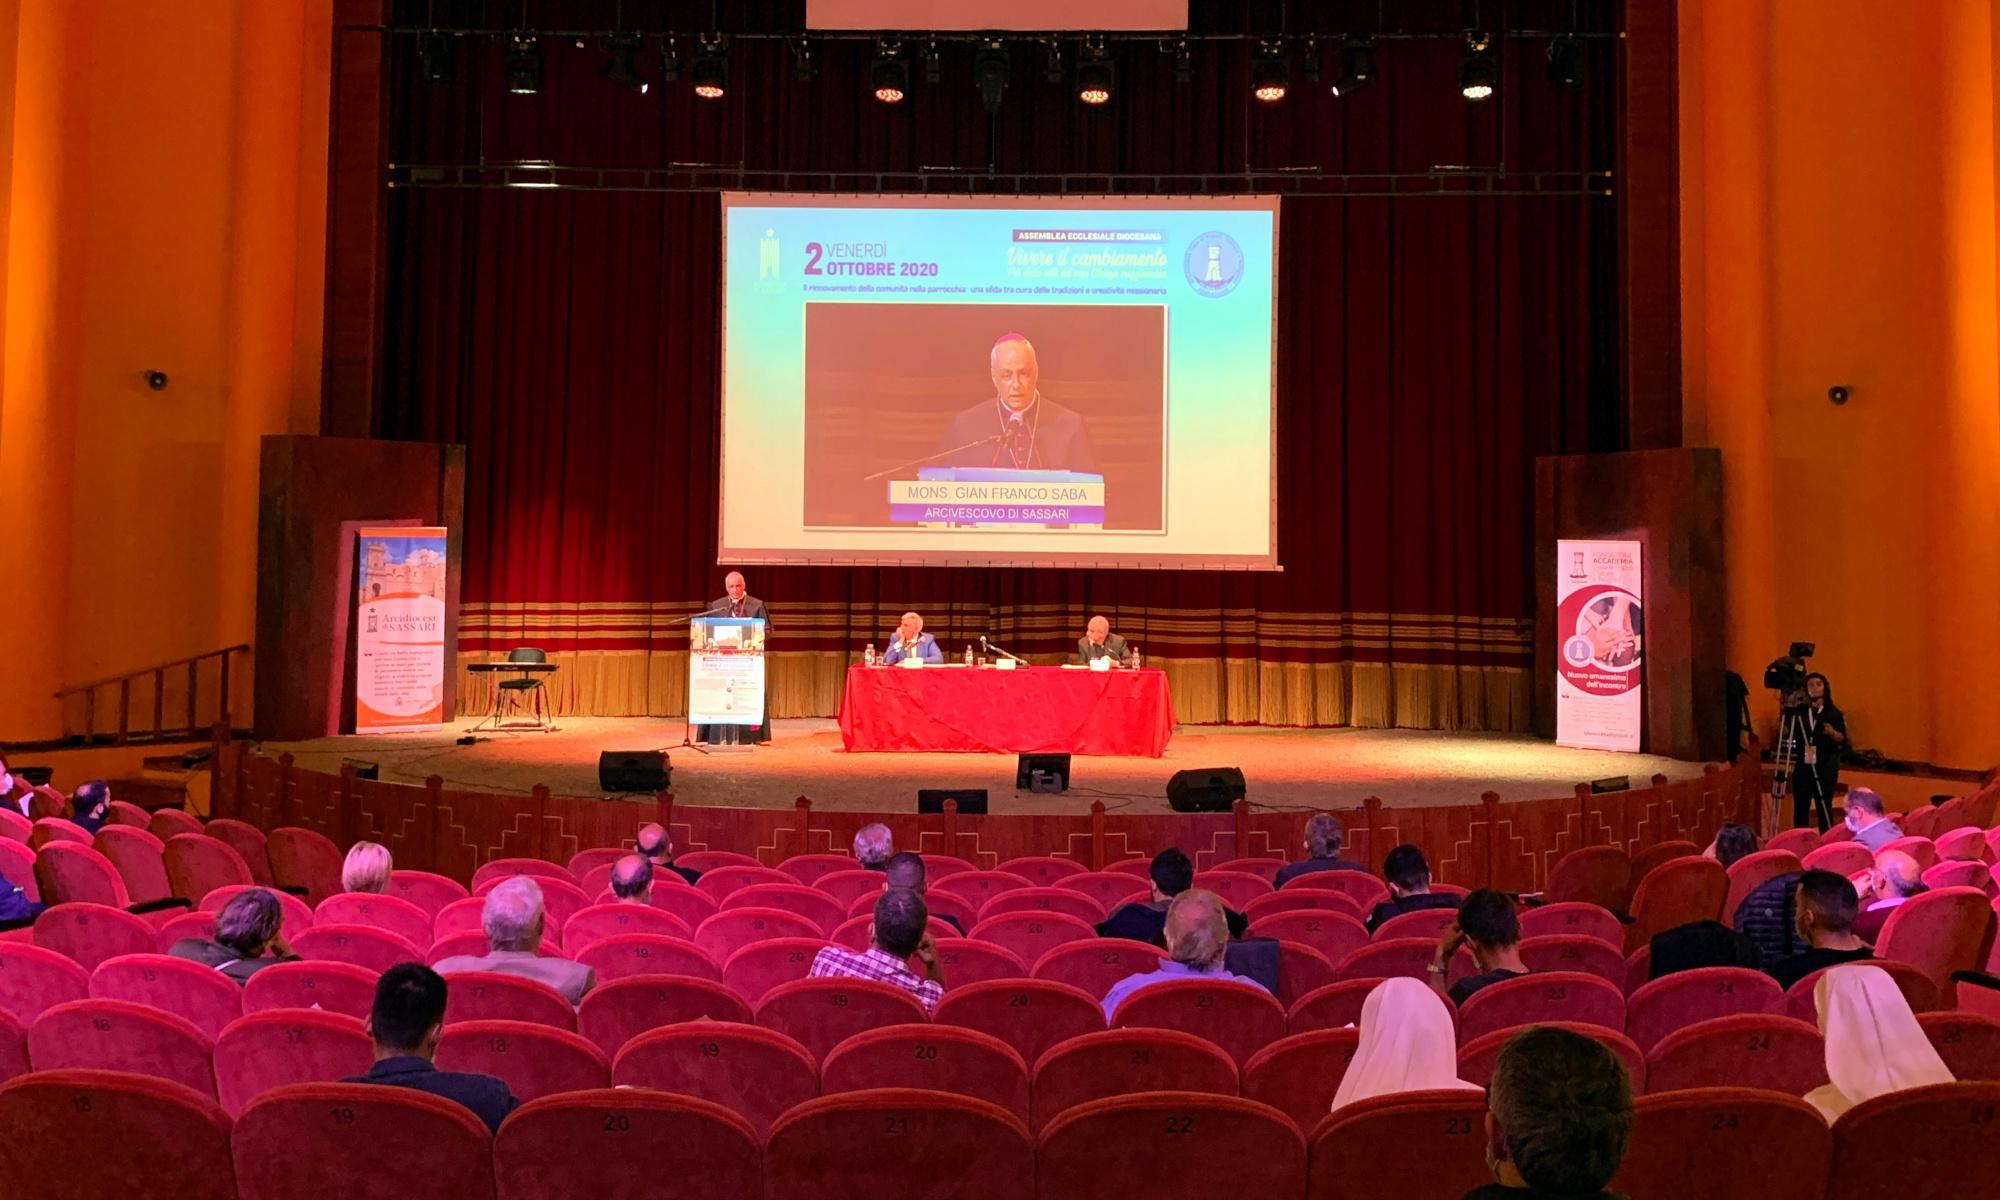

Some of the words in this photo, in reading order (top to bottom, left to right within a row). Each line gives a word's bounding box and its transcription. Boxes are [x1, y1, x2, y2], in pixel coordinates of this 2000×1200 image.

[1018, 232, 1067, 241] ASSEMBLEA
[1067, 232, 1115, 241] ECCLESIALE
[1116, 232, 1161, 241] DIOCESANA
[826, 240, 887, 258] VENERDÌ
[1071, 245, 1168, 268] cambiamento
[803, 241, 823, 276] 2
[826, 261, 896, 276] OTTOBRE
[899, 261, 939, 277] 2020
[955, 486, 988, 499] GIAN
[991, 487, 1048, 500] FRANCO
[1051, 488, 1087, 501] SABA
[924, 508, 1005, 519] ARCIVESCOVO
[1008, 508, 1019, 519] DI
[1022, 508, 1069, 520] SASSARI
[382, 613, 436, 623] Arcidiocesi
[388, 622, 436, 632] SASSARI
[788, 951, 804, 964] 20
[1102, 952, 1121, 965] 22
[1009, 993, 1028, 1008] 20
[700, 1042, 720, 1058] 19
[915, 1045, 937, 1060] 20
[330, 1107, 355, 1125] 19
[604, 1115, 630, 1131] 20
[1712, 1113, 1739, 1131] 24
[884, 1117, 908, 1134] 21
[1165, 1116, 1193, 1134] 22
[1445, 1117, 1472, 1135] 23
